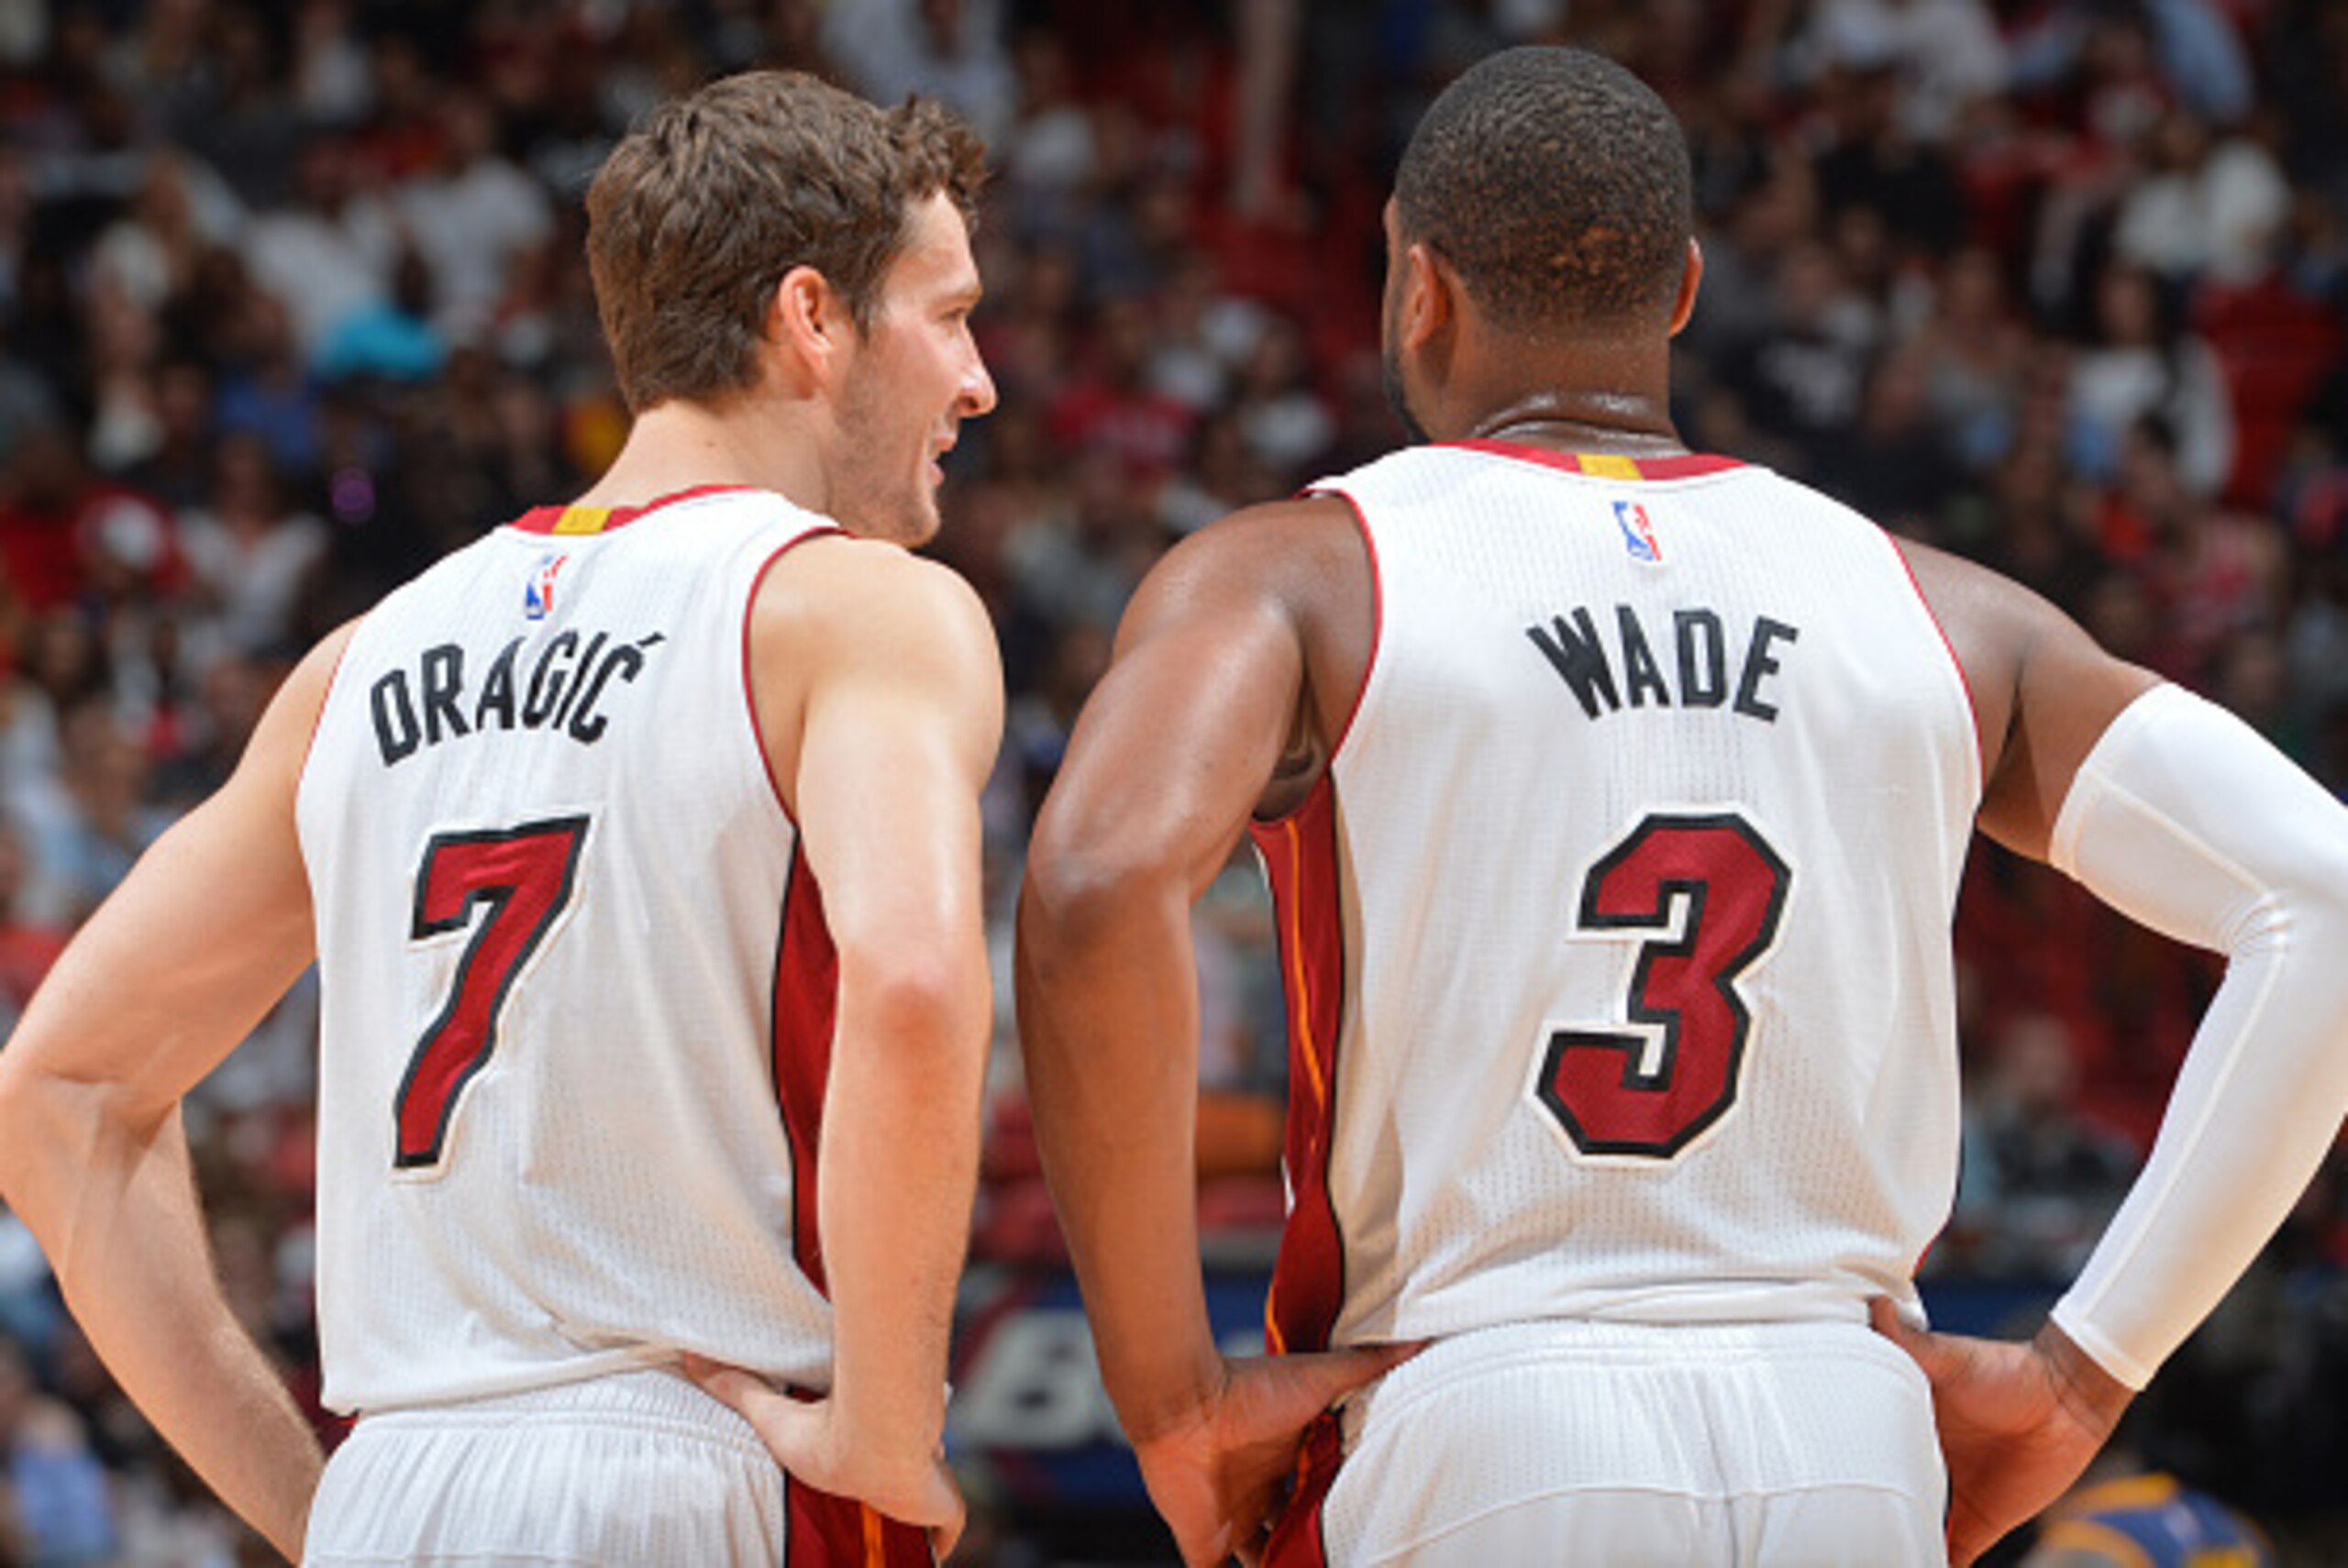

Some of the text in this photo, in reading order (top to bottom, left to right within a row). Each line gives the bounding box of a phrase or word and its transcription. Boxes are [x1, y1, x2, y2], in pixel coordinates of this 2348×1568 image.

[370, 631, 666, 767] DRAGIĆ
[1526, 603, 1800, 723] WADE
[393, 813, 591, 1167] 7
[1535, 812, 1792, 1159] 3
